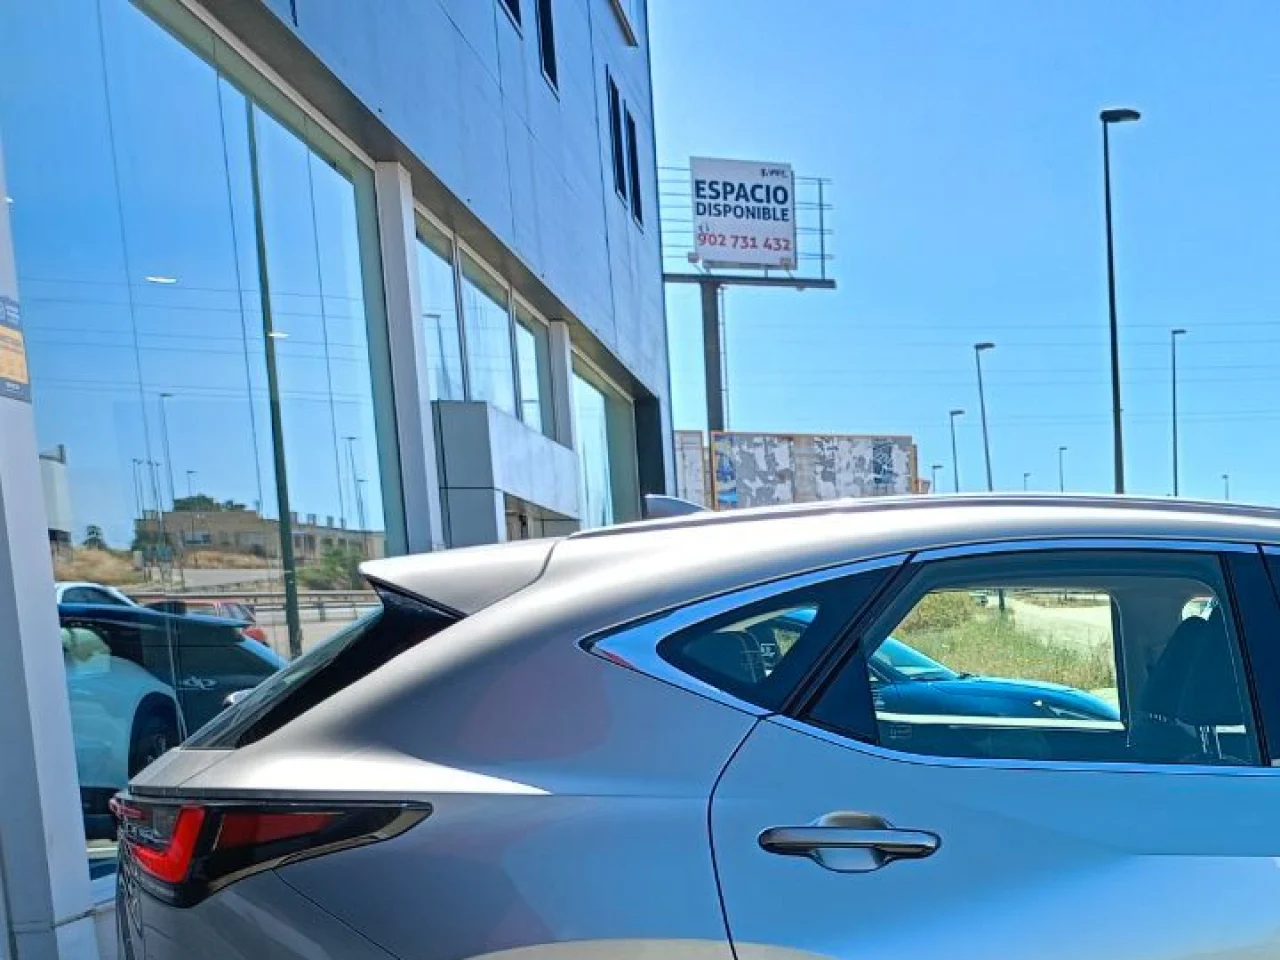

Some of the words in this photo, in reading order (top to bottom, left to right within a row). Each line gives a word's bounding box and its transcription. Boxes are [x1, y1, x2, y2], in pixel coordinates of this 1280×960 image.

[695, 179, 789, 205] ESPACIO
[696, 201, 790, 222] DISPONIBLE
[697, 233, 727, 247] 902
[730, 234, 758, 249] 731
[763, 236, 791, 251] 432
